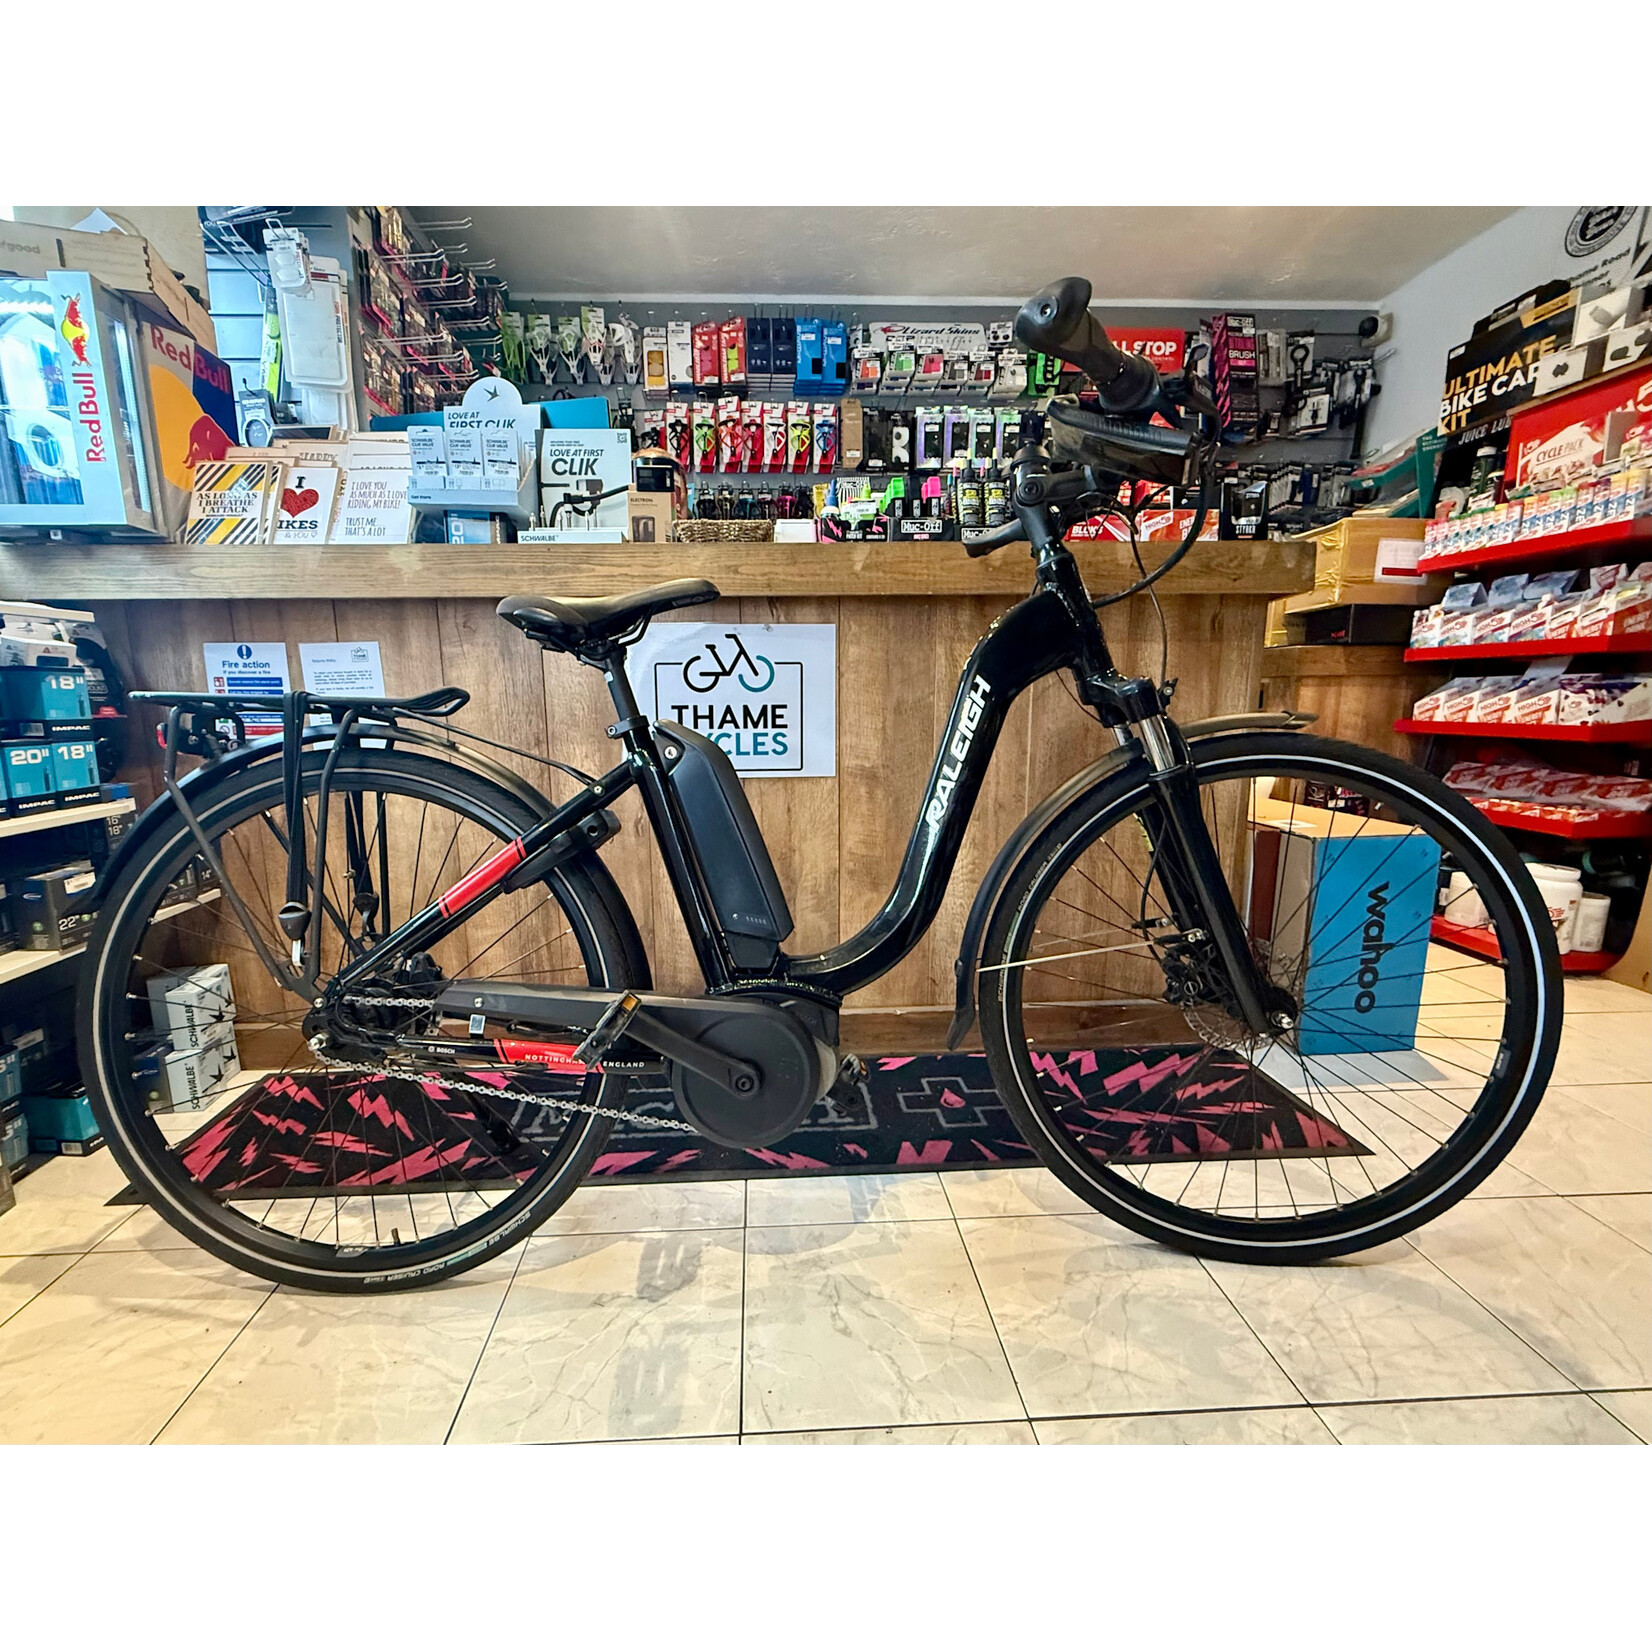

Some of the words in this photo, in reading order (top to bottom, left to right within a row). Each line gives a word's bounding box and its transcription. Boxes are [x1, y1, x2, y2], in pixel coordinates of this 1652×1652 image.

[1601, 247, 1631, 267] Road
[902, 326, 945, 335] Lizard
[945, 326, 980, 335] Skins
[151, 328, 192, 371] Red
[193, 352, 231, 394] Bull
[1229, 350, 1255, 359] BRUSH
[1443, 335, 1557, 398] ULTIMATE
[72, 372, 99, 415] Bull
[1440, 383, 1487, 418] BIKE
[448, 411, 468, 420] LOVE
[469, 411, 480, 420] AT
[1437, 408, 1471, 436] KIT
[80, 419, 106, 462] Red
[1459, 426, 1487, 446] JUICE
[550, 449, 571, 457] LOVE
[571, 449, 583, 457] AT
[583, 449, 605, 457] FIRST
[1536, 443, 1564, 462] CYCLE
[551, 458, 599, 476] CLIK
[295, 476, 306, 488] I
[356, 481, 373, 490] LOVE
[373, 481, 388, 490] YOU
[349, 490, 357, 499] AS
[357, 490, 378, 499] MUCH
[378, 490, 387, 499] AS
[391, 490, 407, 500] LOVE
[347, 499, 372, 509] RIDING
[372, 499, 383, 508] MY
[383, 499, 401, 509] BIKE!
[277, 520, 318, 530] IKES
[346, 517, 365, 526] TRUST
[902, 520, 942, 533] Muc-Off
[345, 526, 366, 536] THAT'S
[366, 527, 372, 536] A
[372, 527, 386, 536] LOT
[222, 661, 239, 669] Fire
[242, 661, 270, 669] action
[50, 674, 84, 690] 18"
[1517, 696, 1552, 712] HIGH5
[671, 704, 788, 729] THAME
[706, 731, 788, 756] CLES
[10, 748, 49, 766] 20"
[57, 744, 94, 760] 18"
[923, 674, 992, 845] RALEIGH
[18, 799, 56, 810] IMPAC
[64, 791, 100, 802] IMPAC
[59, 915, 80, 931] 22"
[1354, 881, 1394, 1014] wahoo
[185, 1004, 199, 1048] SCHWALBE
[185, 1065, 200, 1110] SCHWALBE
[488, 1211, 531, 1246] SCHWALBE
[387, 1269, 421, 1281] CRUISER
[423, 1262, 445, 1275] ROAD
